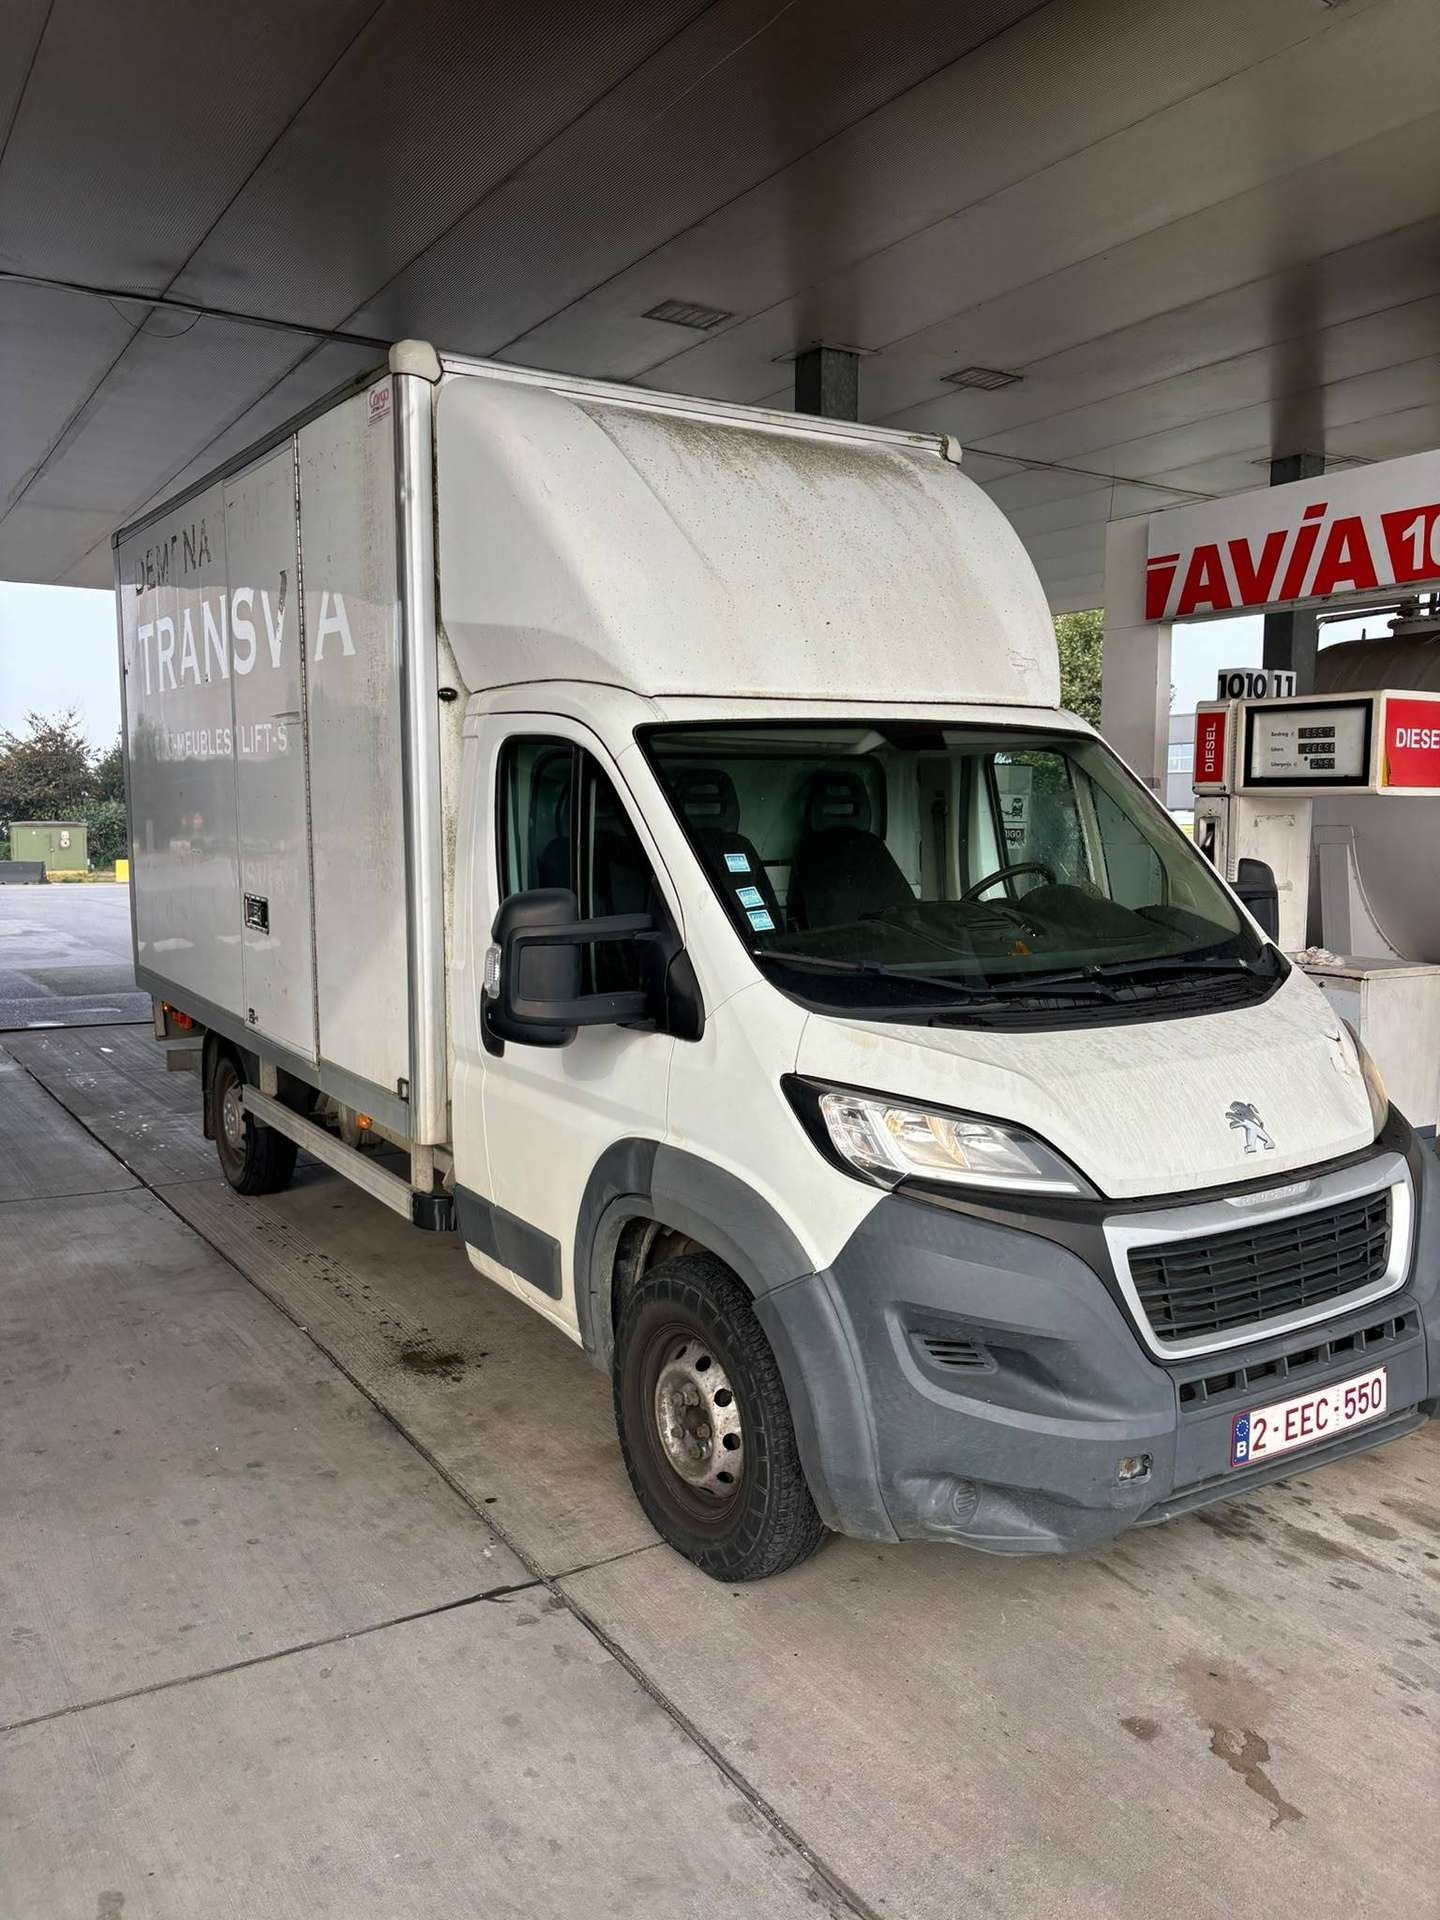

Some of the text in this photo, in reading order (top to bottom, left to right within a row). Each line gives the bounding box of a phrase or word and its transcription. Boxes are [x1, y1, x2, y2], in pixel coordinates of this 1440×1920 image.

[1218, 673, 1245, 699] 10
[1245, 673, 1267, 699] 10
[1274, 674, 1294, 698] 11
[1204, 722, 1217, 774] DIESEL
[1252, 1377, 1382, 1453] 2-EEC-550
[1235, 1440, 1248, 1458] B
